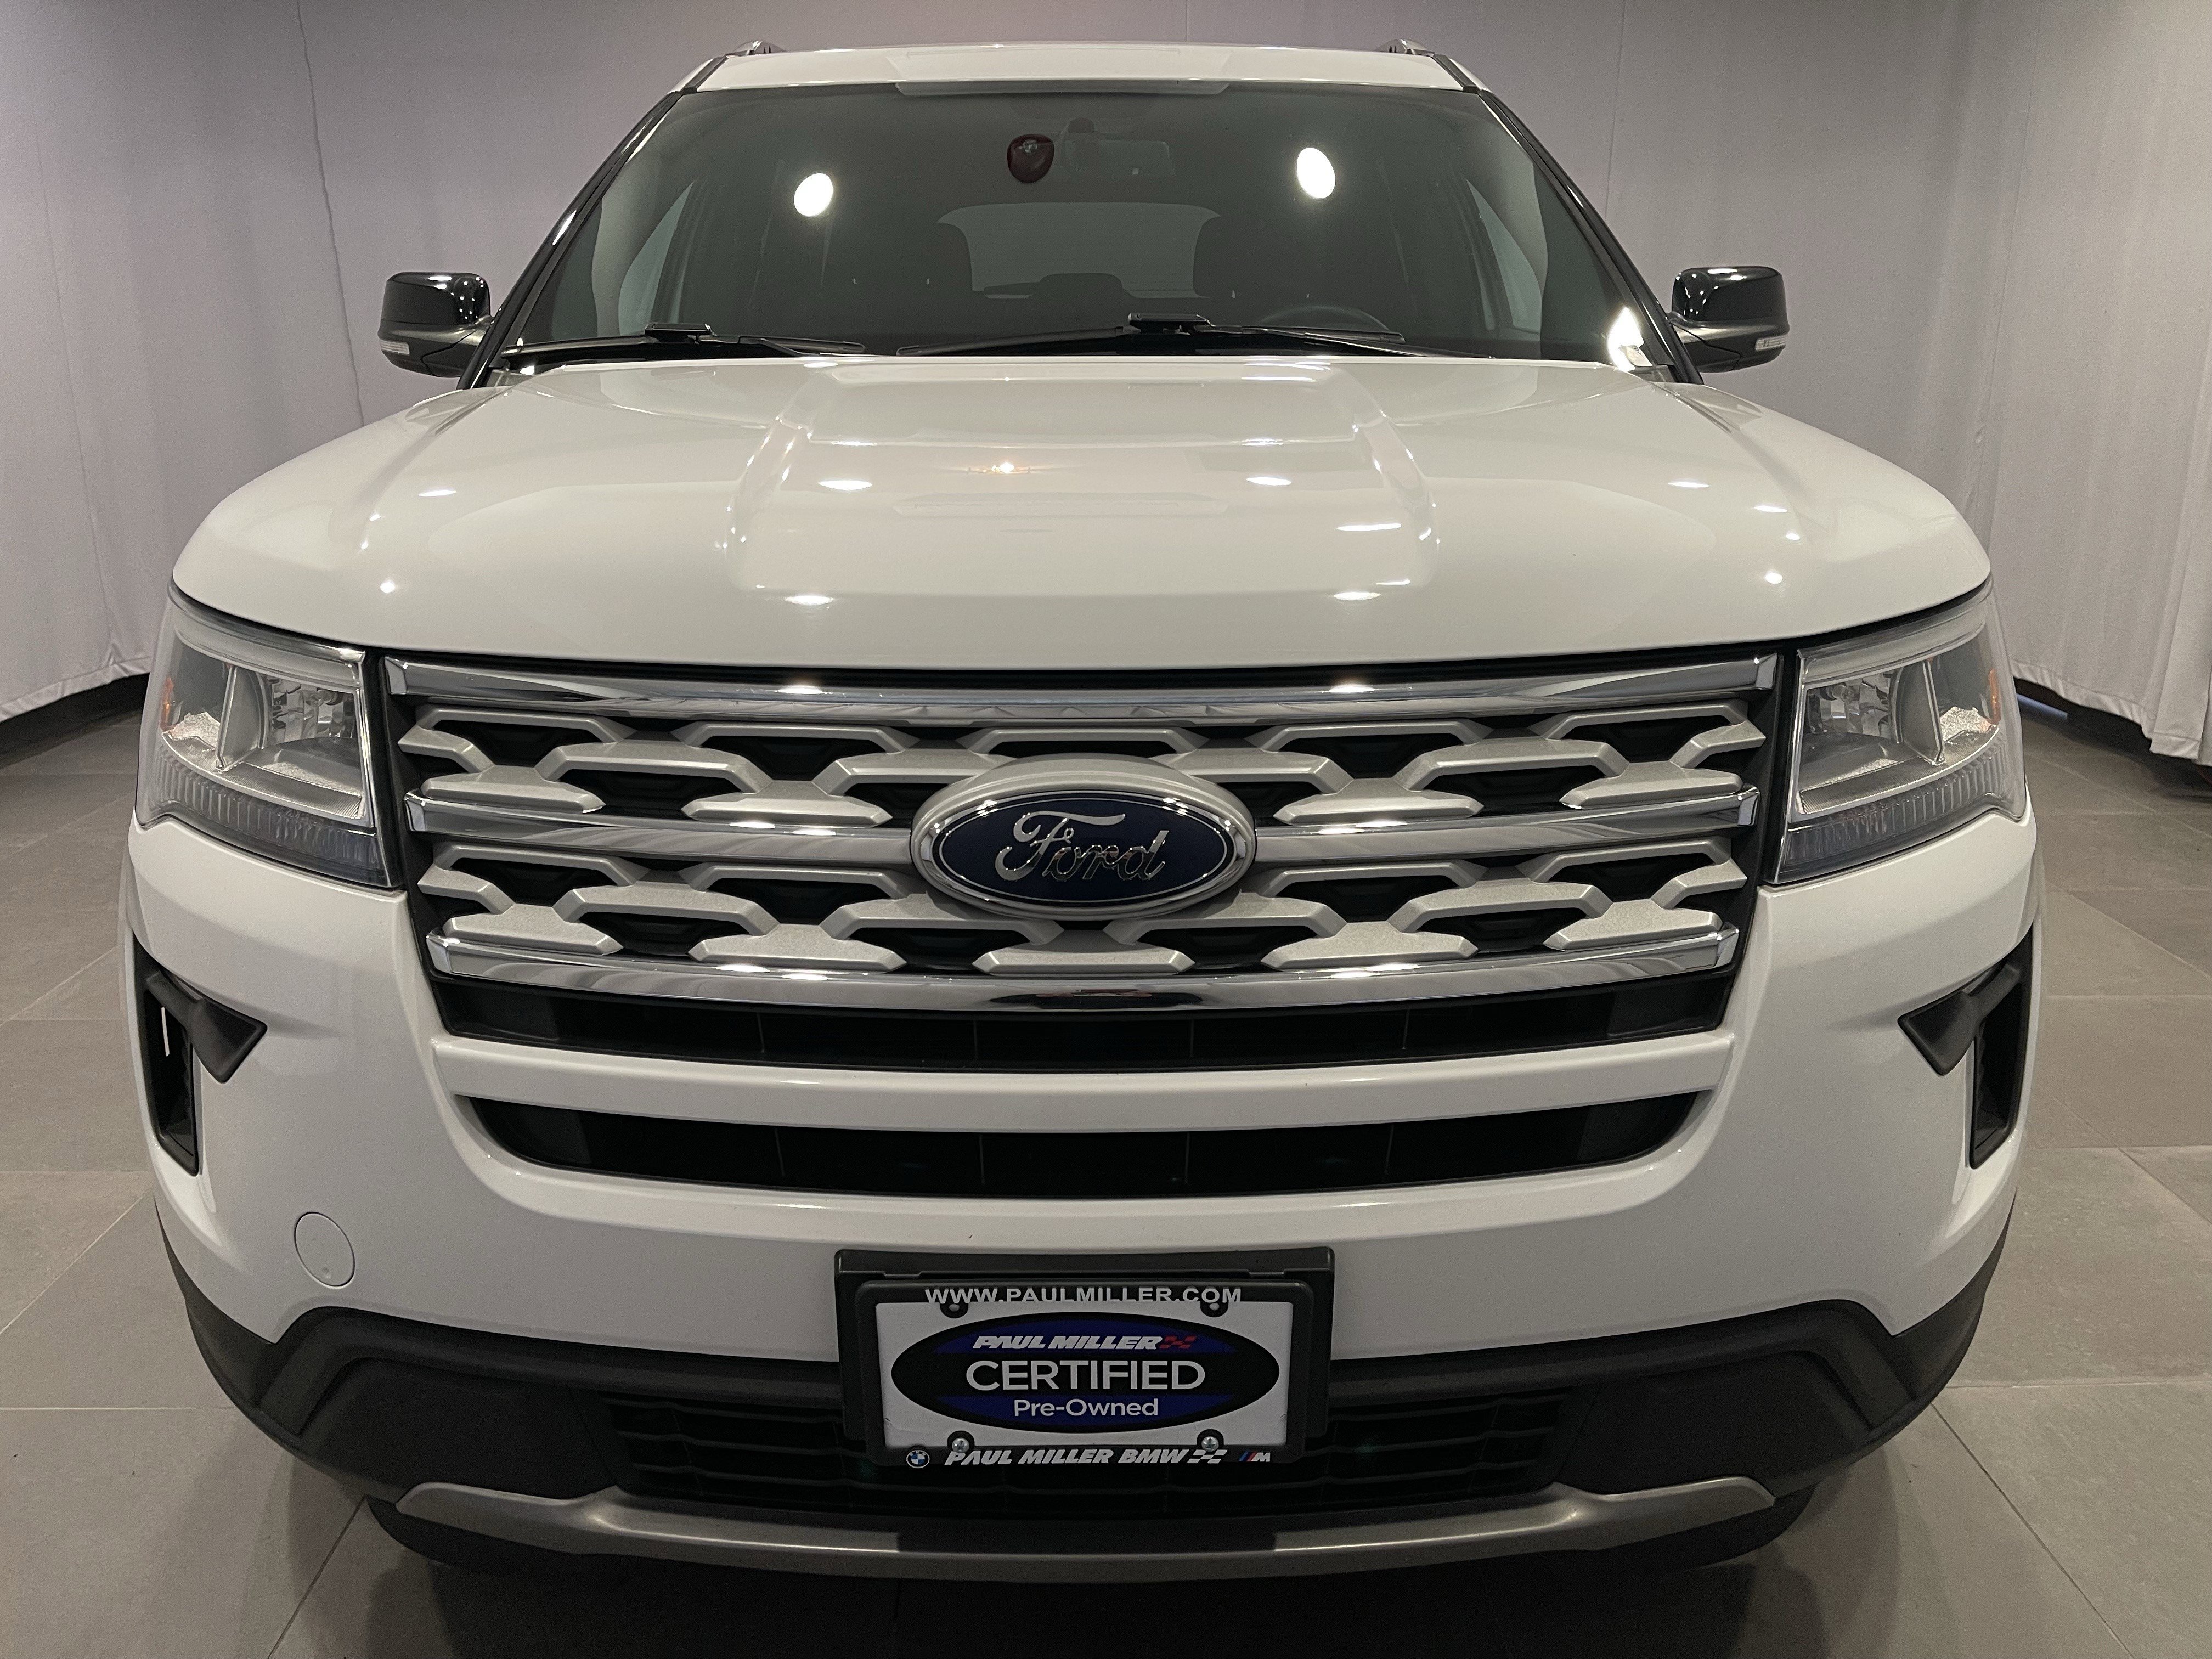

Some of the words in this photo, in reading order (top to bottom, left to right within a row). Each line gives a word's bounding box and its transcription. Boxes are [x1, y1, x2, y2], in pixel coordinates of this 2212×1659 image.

[995, 810, 1169, 881] Ford
[924, 1287, 1242, 1304] WWW.PAULMILLER.COM
[972, 1335, 1046, 1350] PAUL
[1048, 1335, 1163, 1350] MILLER
[966, 1360, 1206, 1391] CERTIFIED
[1014, 1398, 1159, 1417] Pre-Owned
[944, 1450, 1013, 1466] PAUL
[1018, 1448, 1114, 1464] MILLER
[1118, 1448, 1190, 1464] BMW
